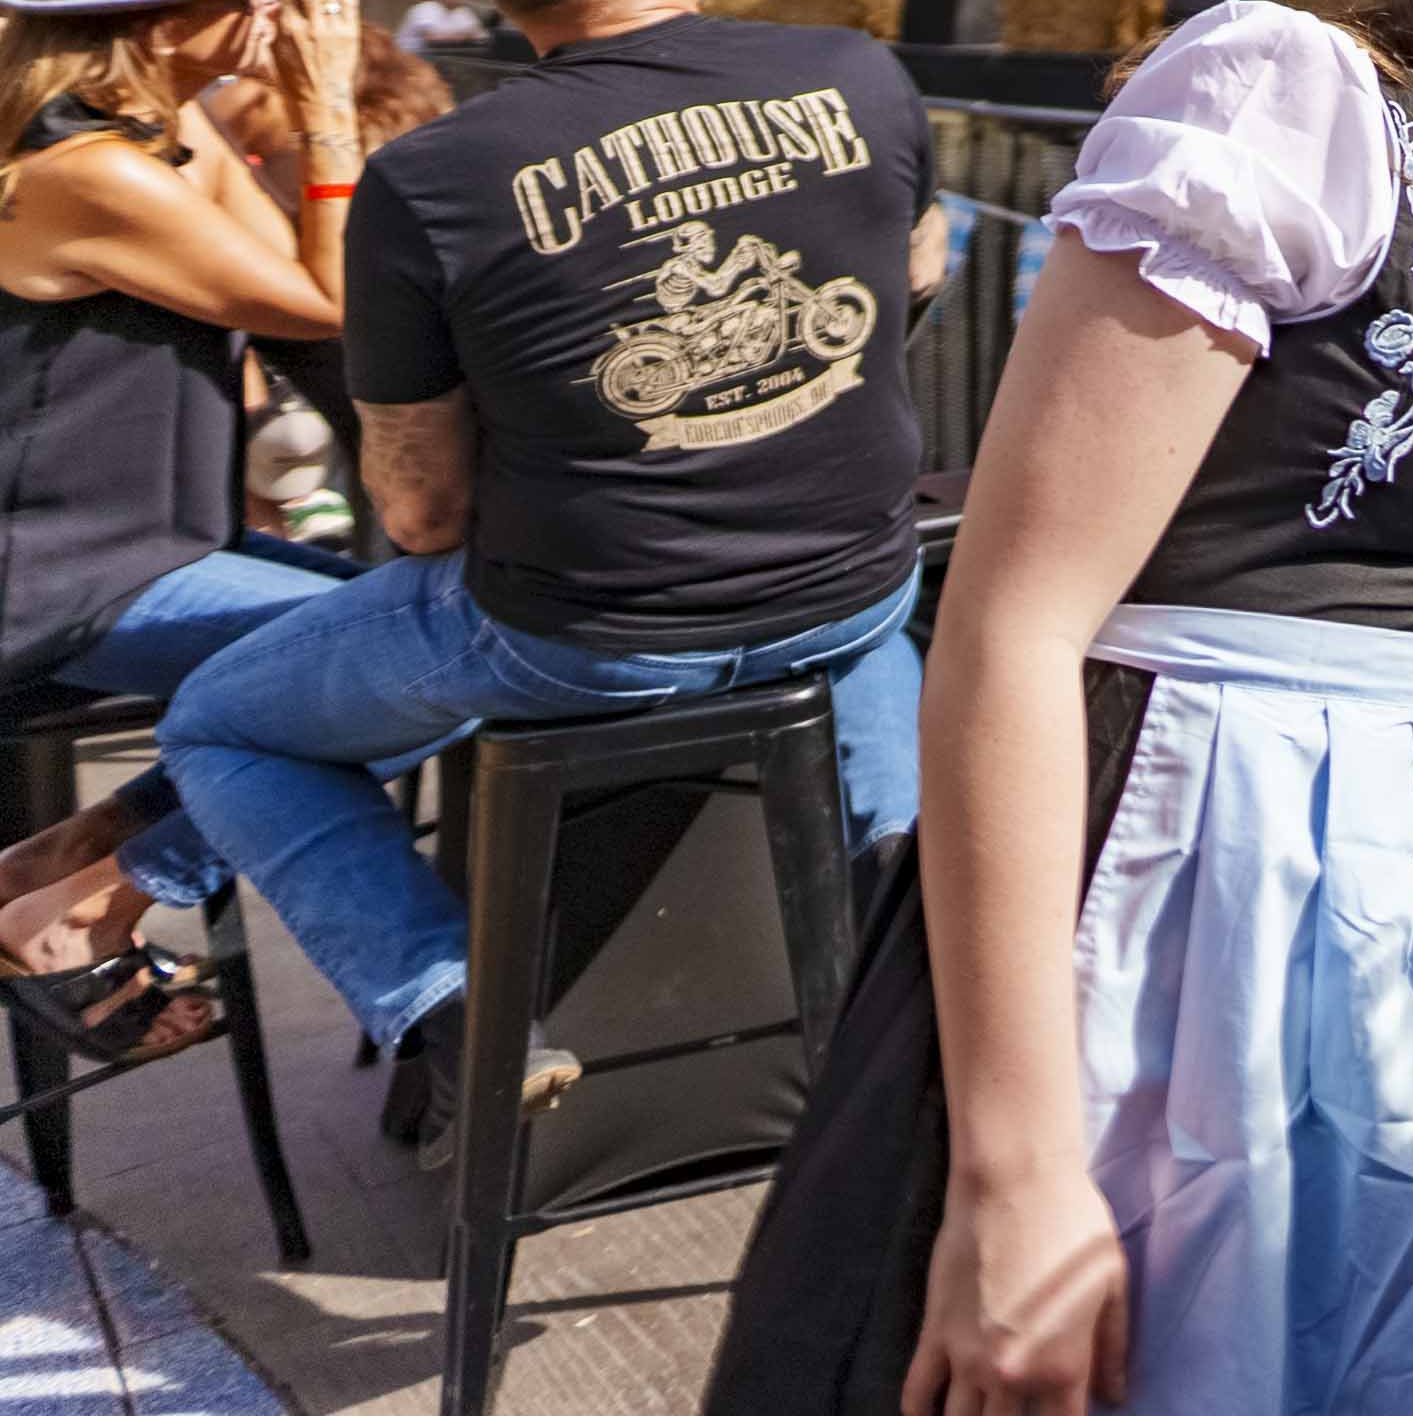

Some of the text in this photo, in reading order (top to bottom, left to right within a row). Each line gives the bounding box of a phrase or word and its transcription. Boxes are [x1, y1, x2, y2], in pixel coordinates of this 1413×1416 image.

[512, 87, 871, 256] CATHOUSE
[624, 161, 799, 232] LOUNGE
[704, 385, 753, 411] EST.
